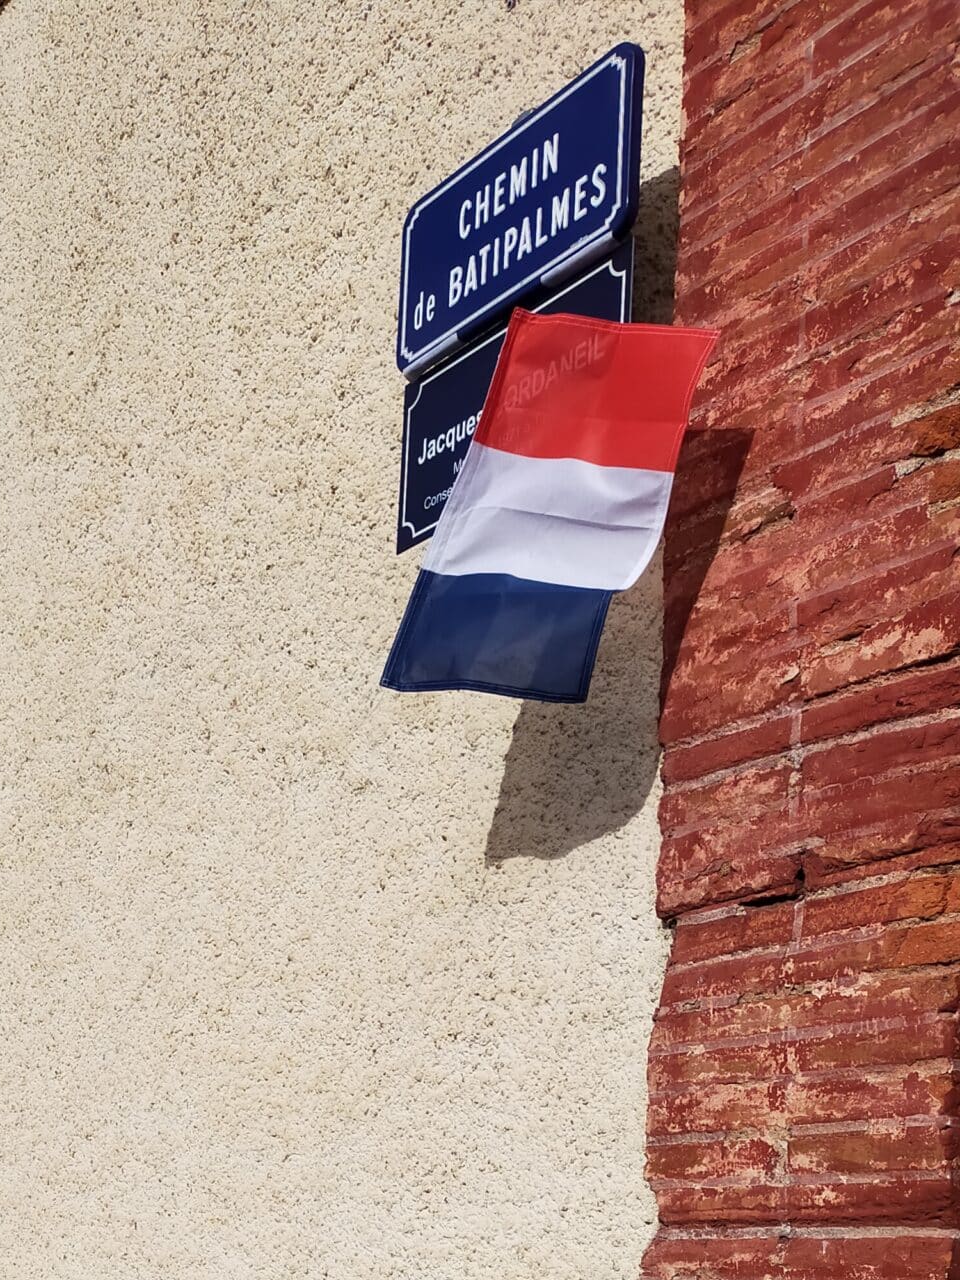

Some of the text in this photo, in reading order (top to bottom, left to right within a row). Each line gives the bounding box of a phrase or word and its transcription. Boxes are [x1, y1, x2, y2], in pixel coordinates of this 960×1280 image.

[458, 132, 560, 240] CHEMIN
[413, 163, 608, 331] de BATIPALMES
[424, 487, 453, 510] Conse
